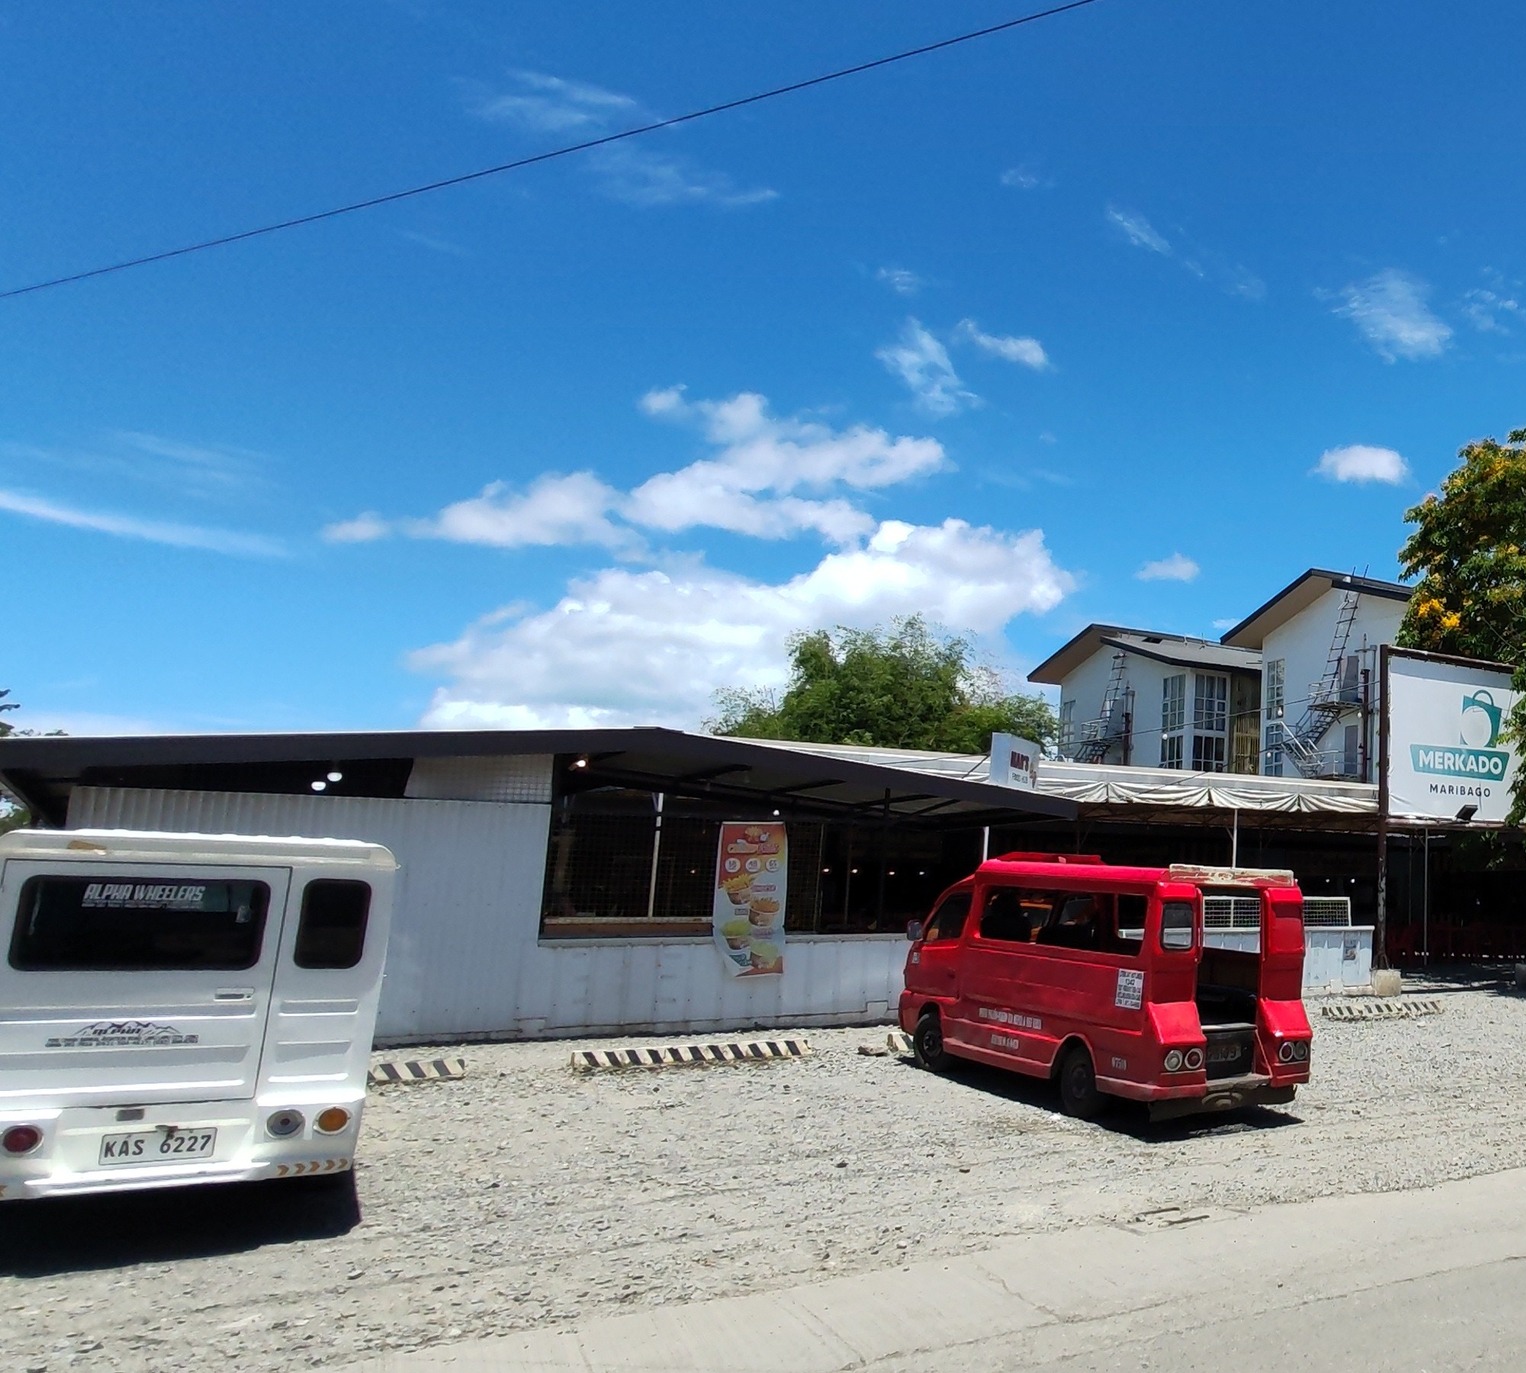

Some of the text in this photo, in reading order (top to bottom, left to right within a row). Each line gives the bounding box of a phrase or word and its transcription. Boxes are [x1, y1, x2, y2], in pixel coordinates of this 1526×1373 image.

[1419, 749, 1503, 775] MERKADO
[1429, 784, 1491, 797] MARIBAGO
[83, 883, 206, 901] ALPHA WHEELERS
[104, 1134, 212, 1158] KAS 6227
